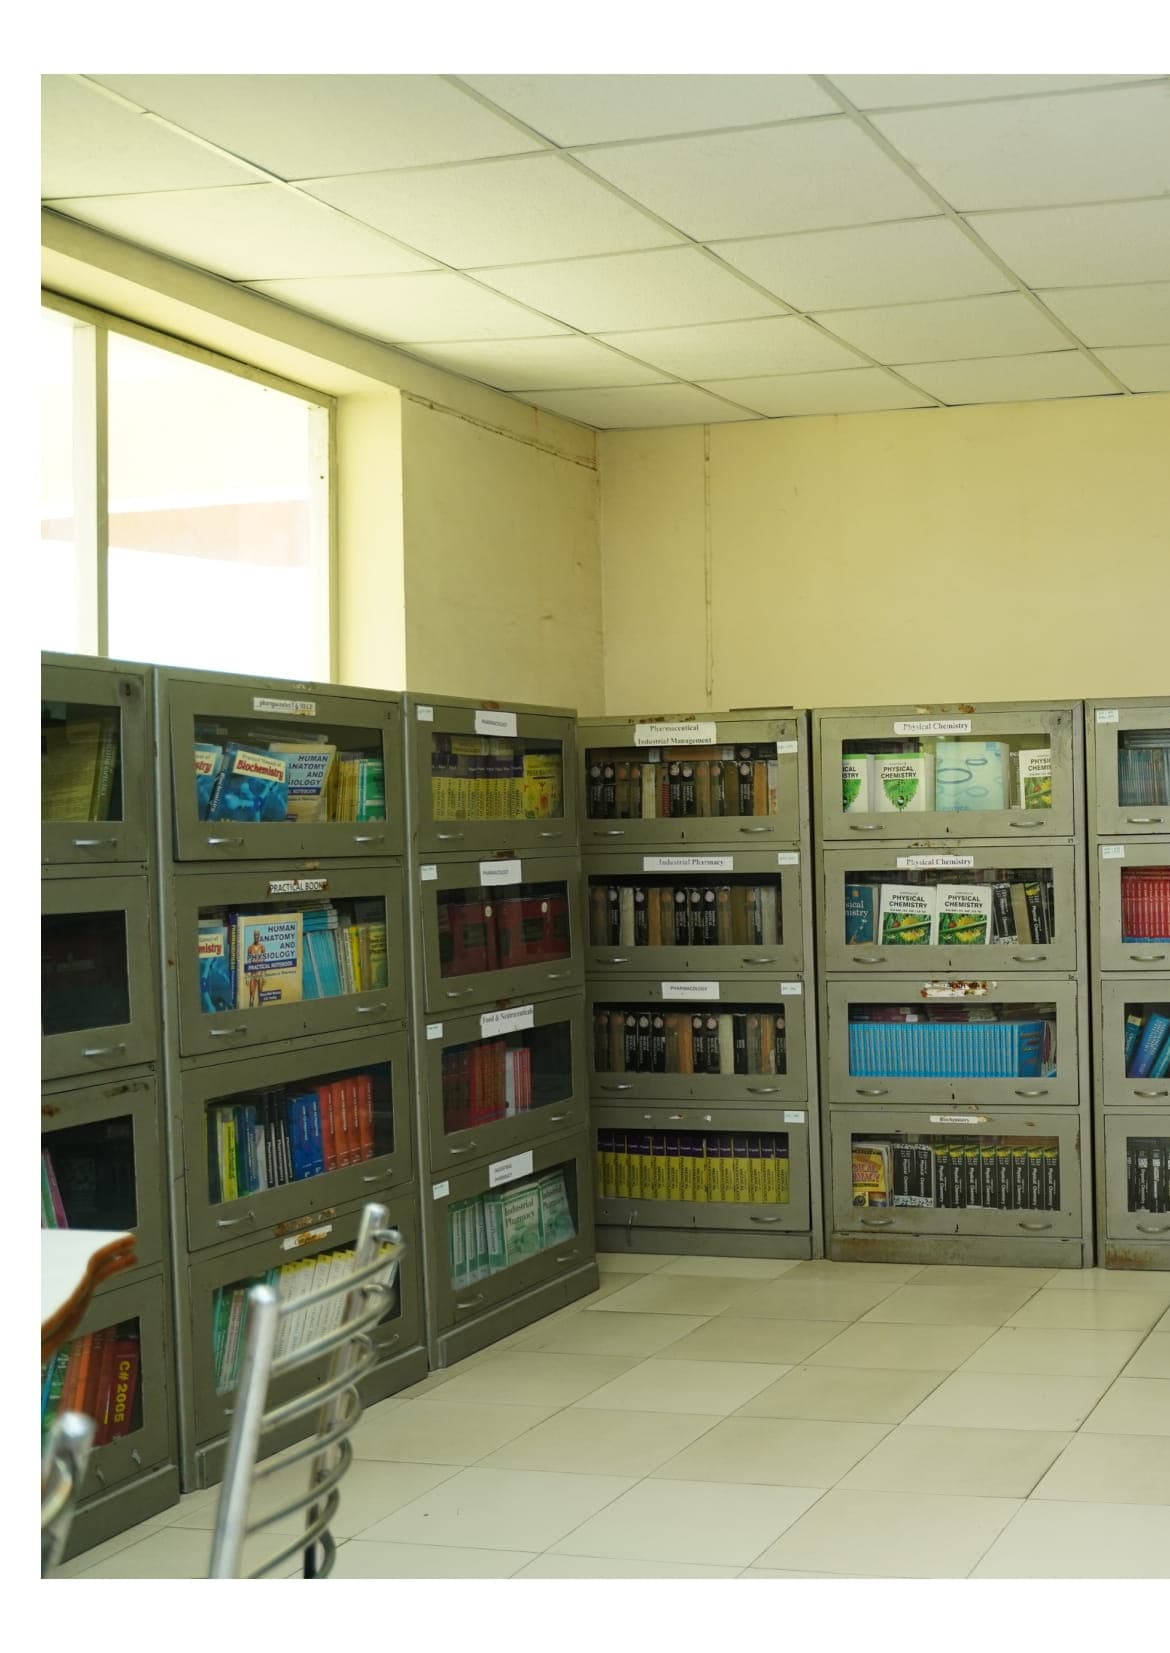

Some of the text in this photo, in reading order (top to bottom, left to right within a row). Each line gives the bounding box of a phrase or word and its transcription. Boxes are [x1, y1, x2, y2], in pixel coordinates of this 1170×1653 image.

[650, 724, 699, 732] Pharmaceutical
[933, 722, 968, 730] Chemistry
[236, 760, 284, 780] Biochemistry
[692, 858, 723, 866] Pharmacy
[936, 858, 971, 866] Chemistry
[268, 924, 295, 933] HUMAN
[260, 933, 295, 942] ANATOMY
[248, 950, 295, 960] PHYSIOLOGY
[504, 1199, 533, 1216] Industrial
[114, 1360, 130, 1423] C# 2005
